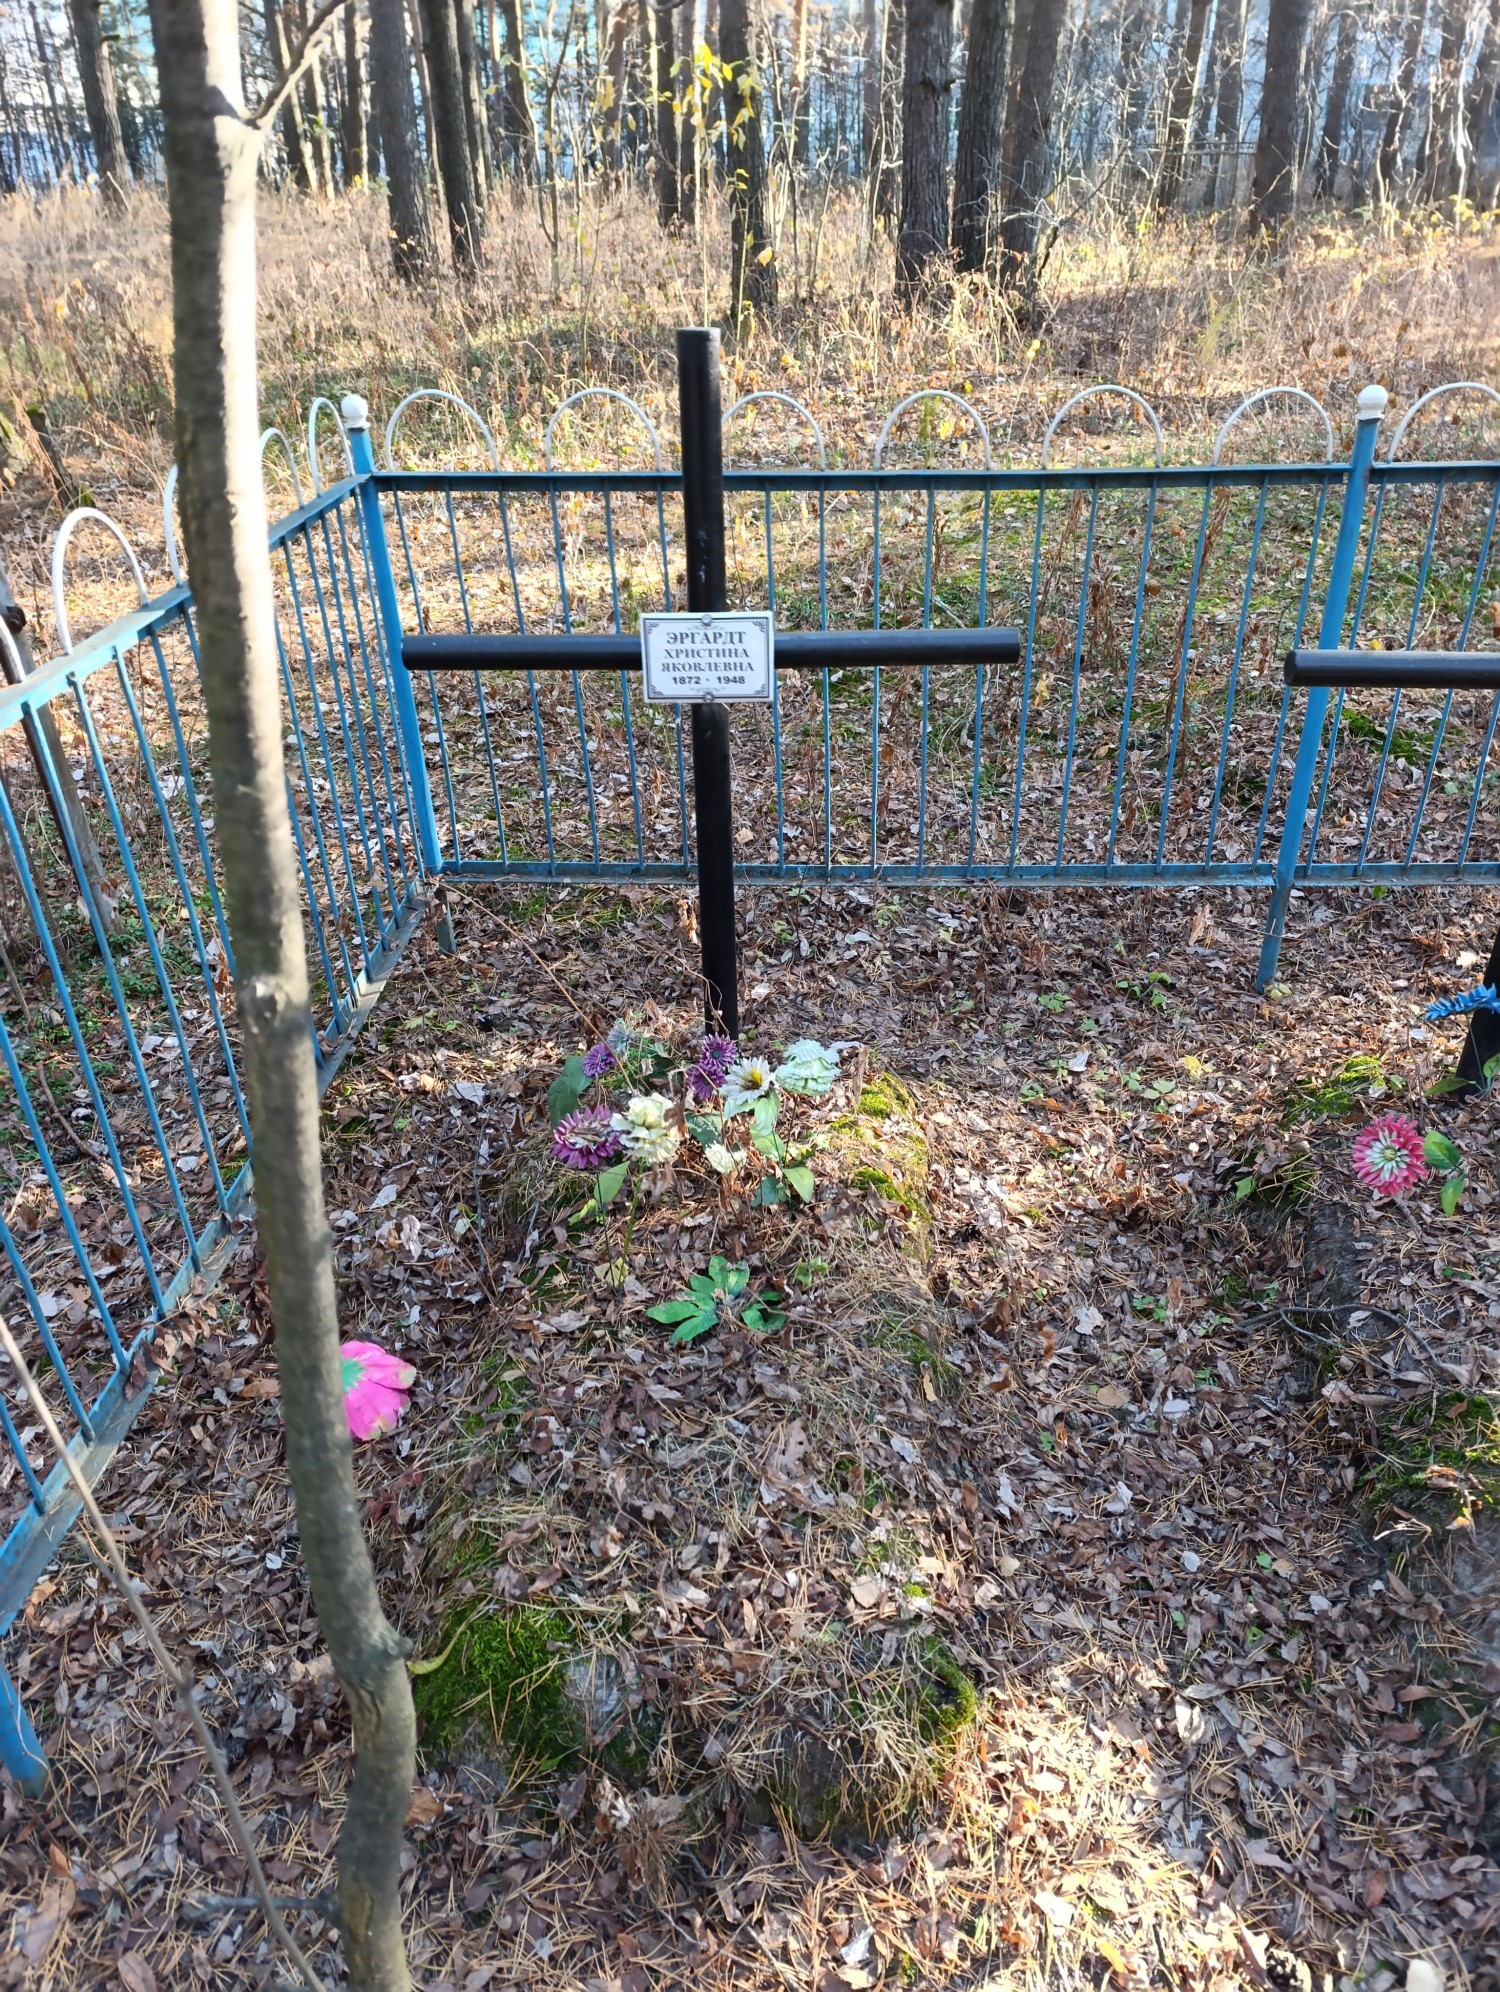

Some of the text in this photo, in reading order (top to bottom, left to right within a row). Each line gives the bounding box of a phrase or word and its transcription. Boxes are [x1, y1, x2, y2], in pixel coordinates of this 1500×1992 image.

[666, 631, 747, 645] ЭРГАРДТ
[664, 648, 750, 659] ХРИСТИНА
[661, 662, 755, 672] ЯКОВЛЕВНА
[671, 675, 746, 685] 1872 1948
